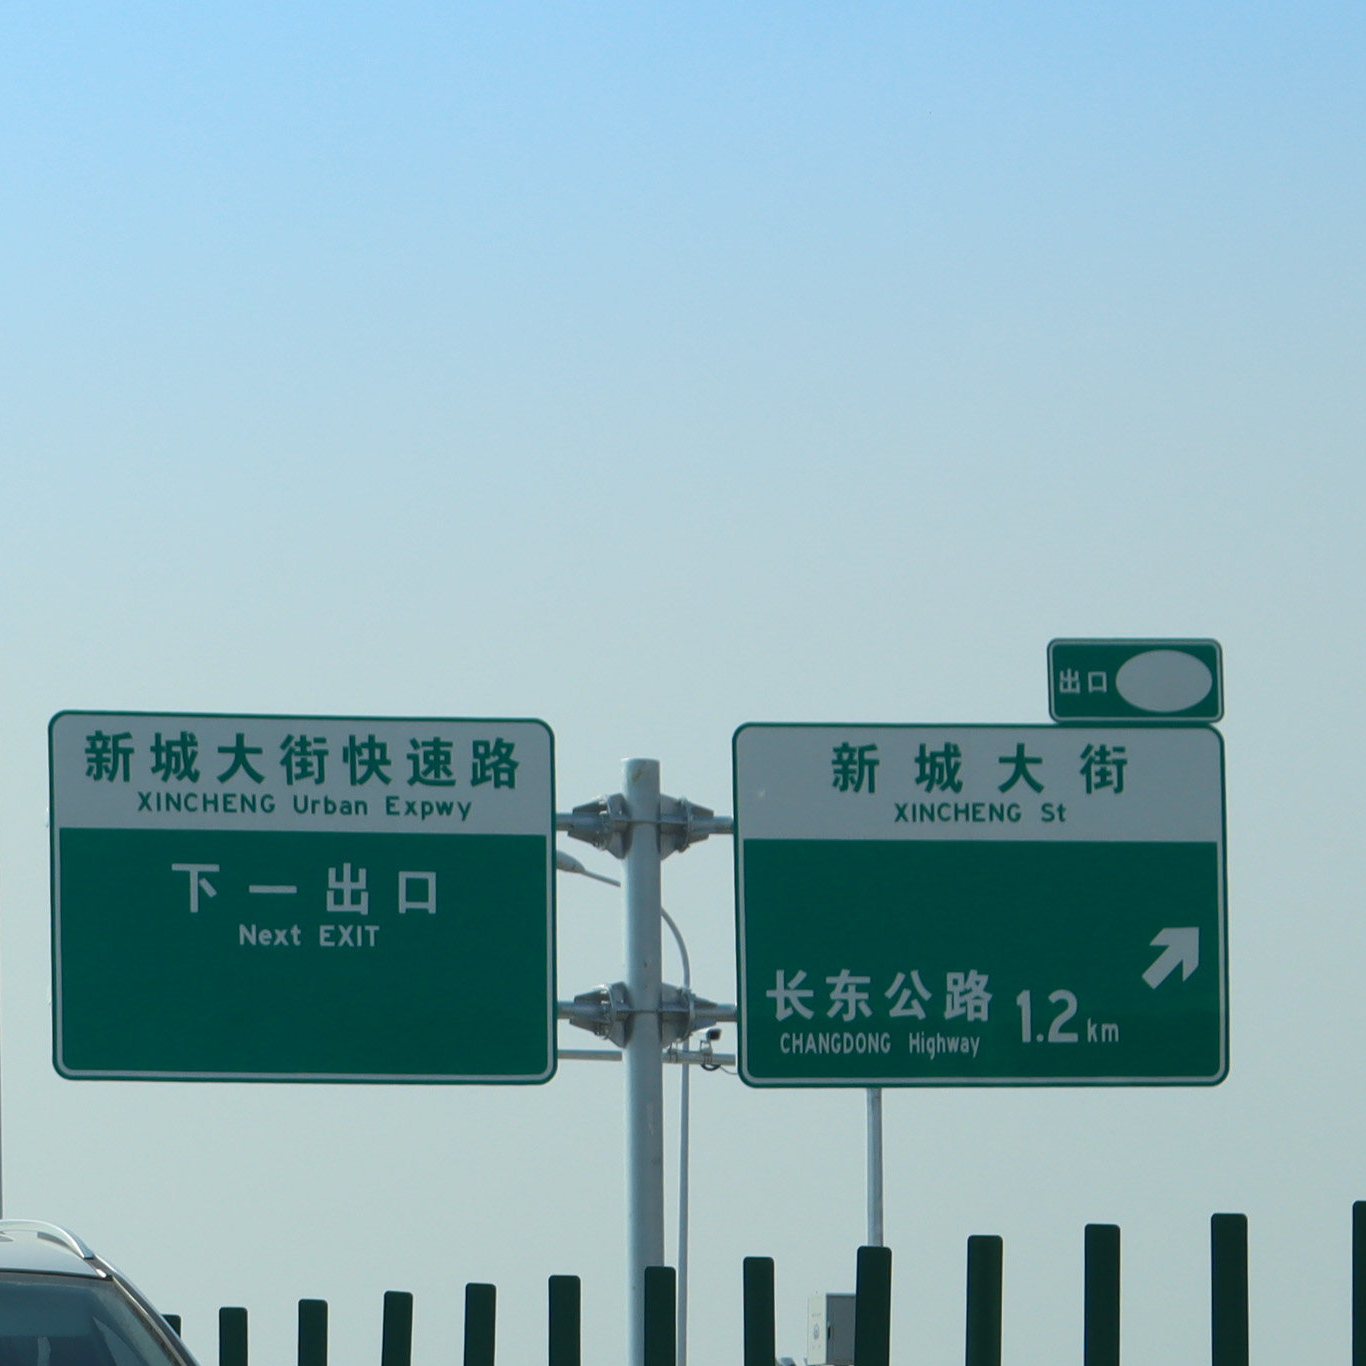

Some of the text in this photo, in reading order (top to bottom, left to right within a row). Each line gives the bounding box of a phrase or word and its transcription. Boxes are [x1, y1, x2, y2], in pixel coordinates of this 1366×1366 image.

[1058, 667, 1108, 694] 出口
[84, 730, 520, 789] 新城大街快速路
[831, 742, 1128, 794] 新城大街
[137, 791, 472, 821] XINCHENG Urban Expwy
[893, 802, 1067, 823] XINCHENG St
[171, 862, 437, 915] 下一出口
[239, 924, 380, 947] Next EXIT
[766, 968, 993, 1022] 长东公路
[780, 1032, 980, 1060] CHANGDONG Highway
